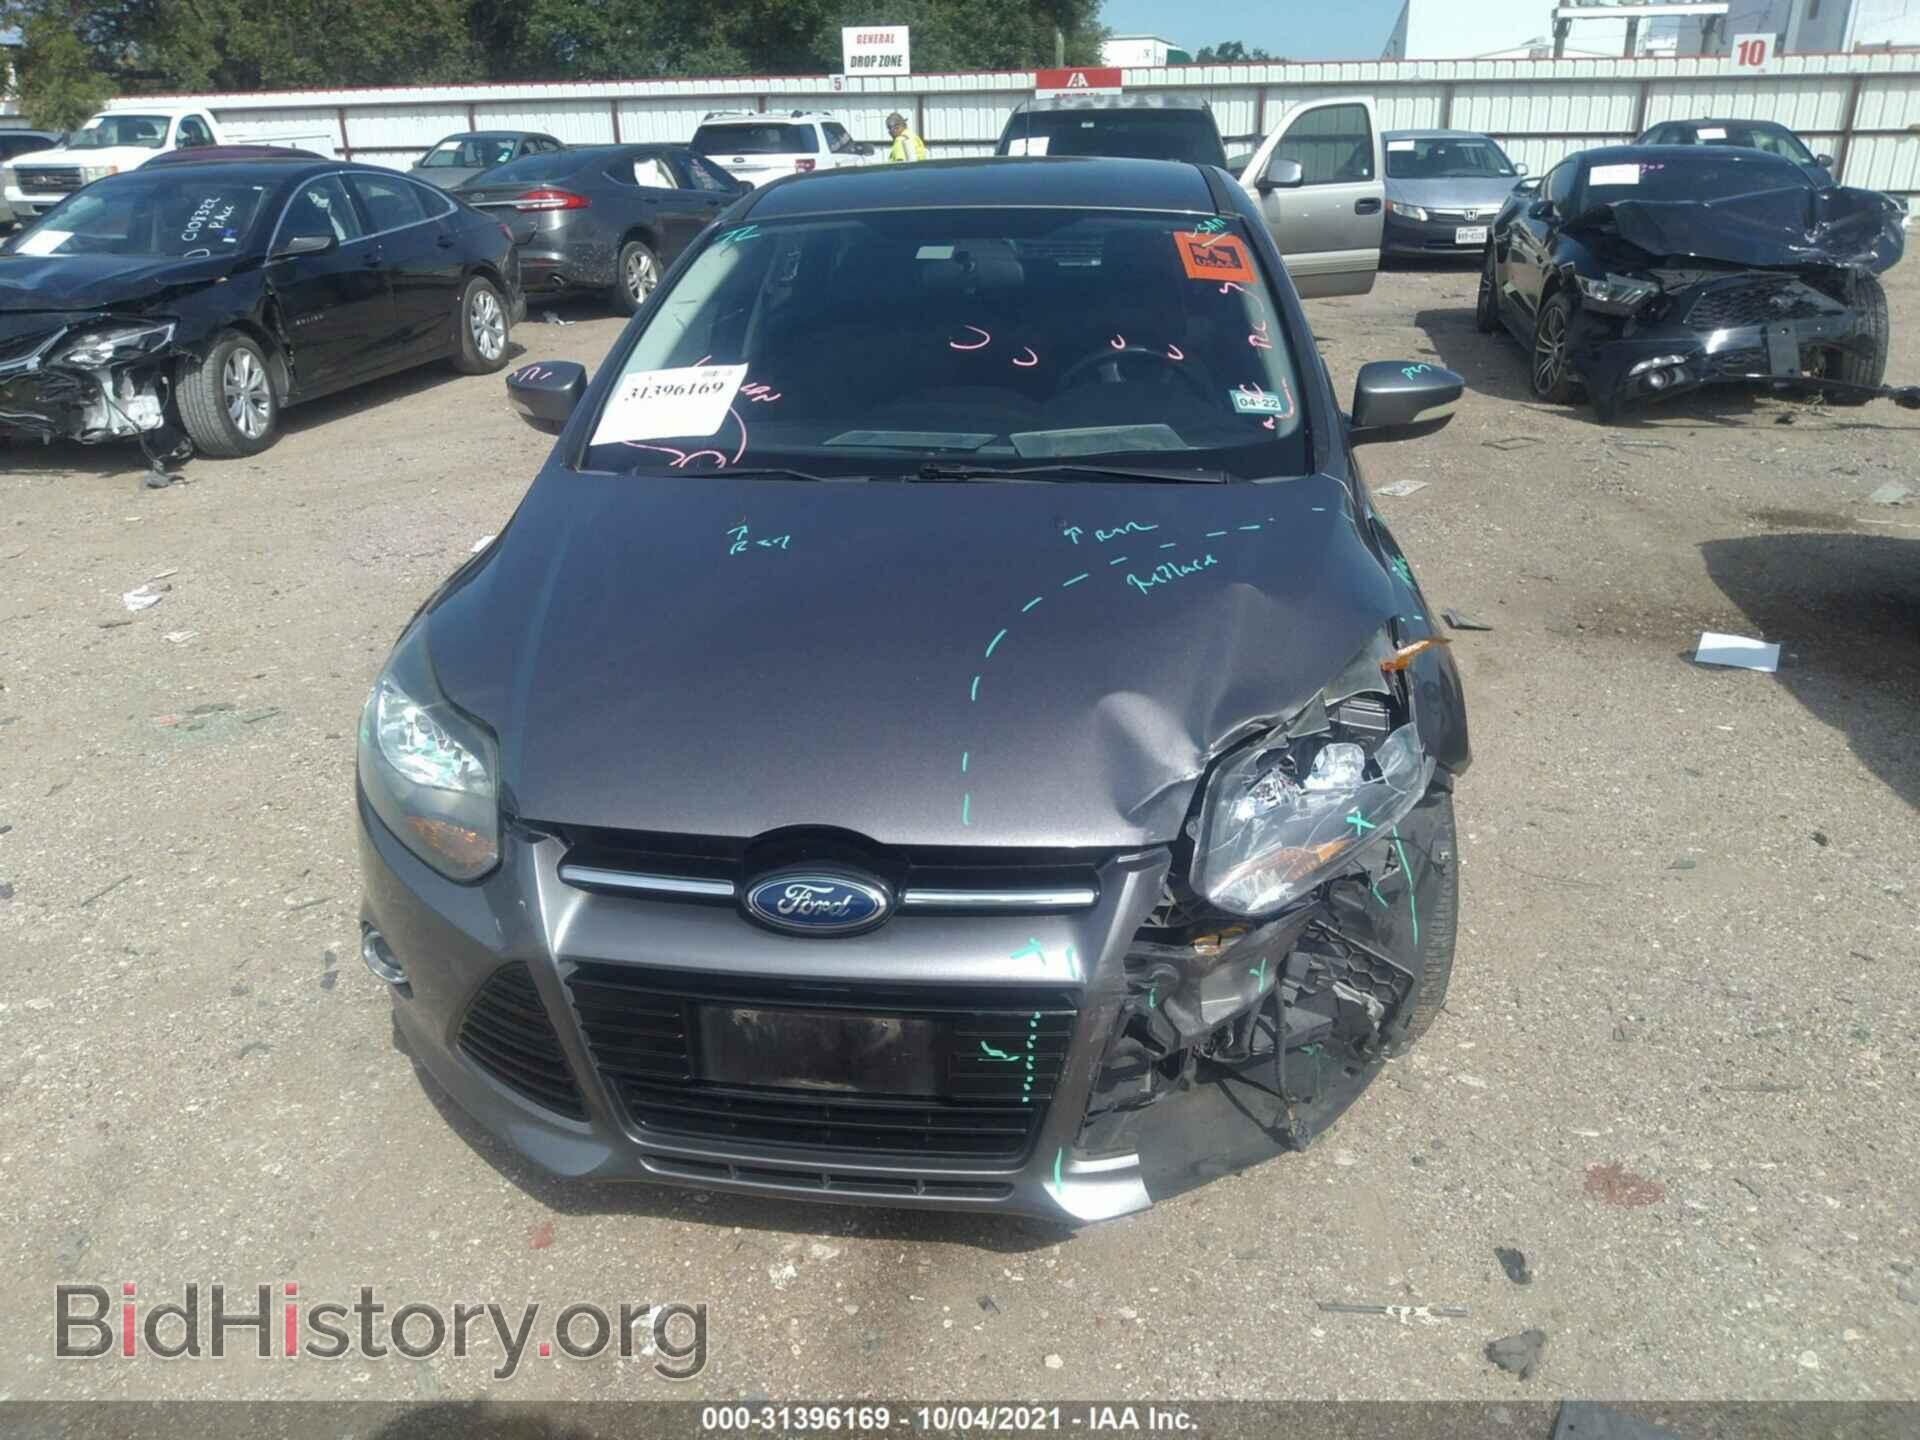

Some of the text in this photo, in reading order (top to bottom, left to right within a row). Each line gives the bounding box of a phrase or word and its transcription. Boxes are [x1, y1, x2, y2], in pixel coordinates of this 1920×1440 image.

[857, 33, 896, 44] GENERAL
[1737, 39, 1766, 67] 10
[850, 54, 903, 68] DROP ZONE
[834, 76, 843, 91] 5
[776, 884, 854, 917] Ford
